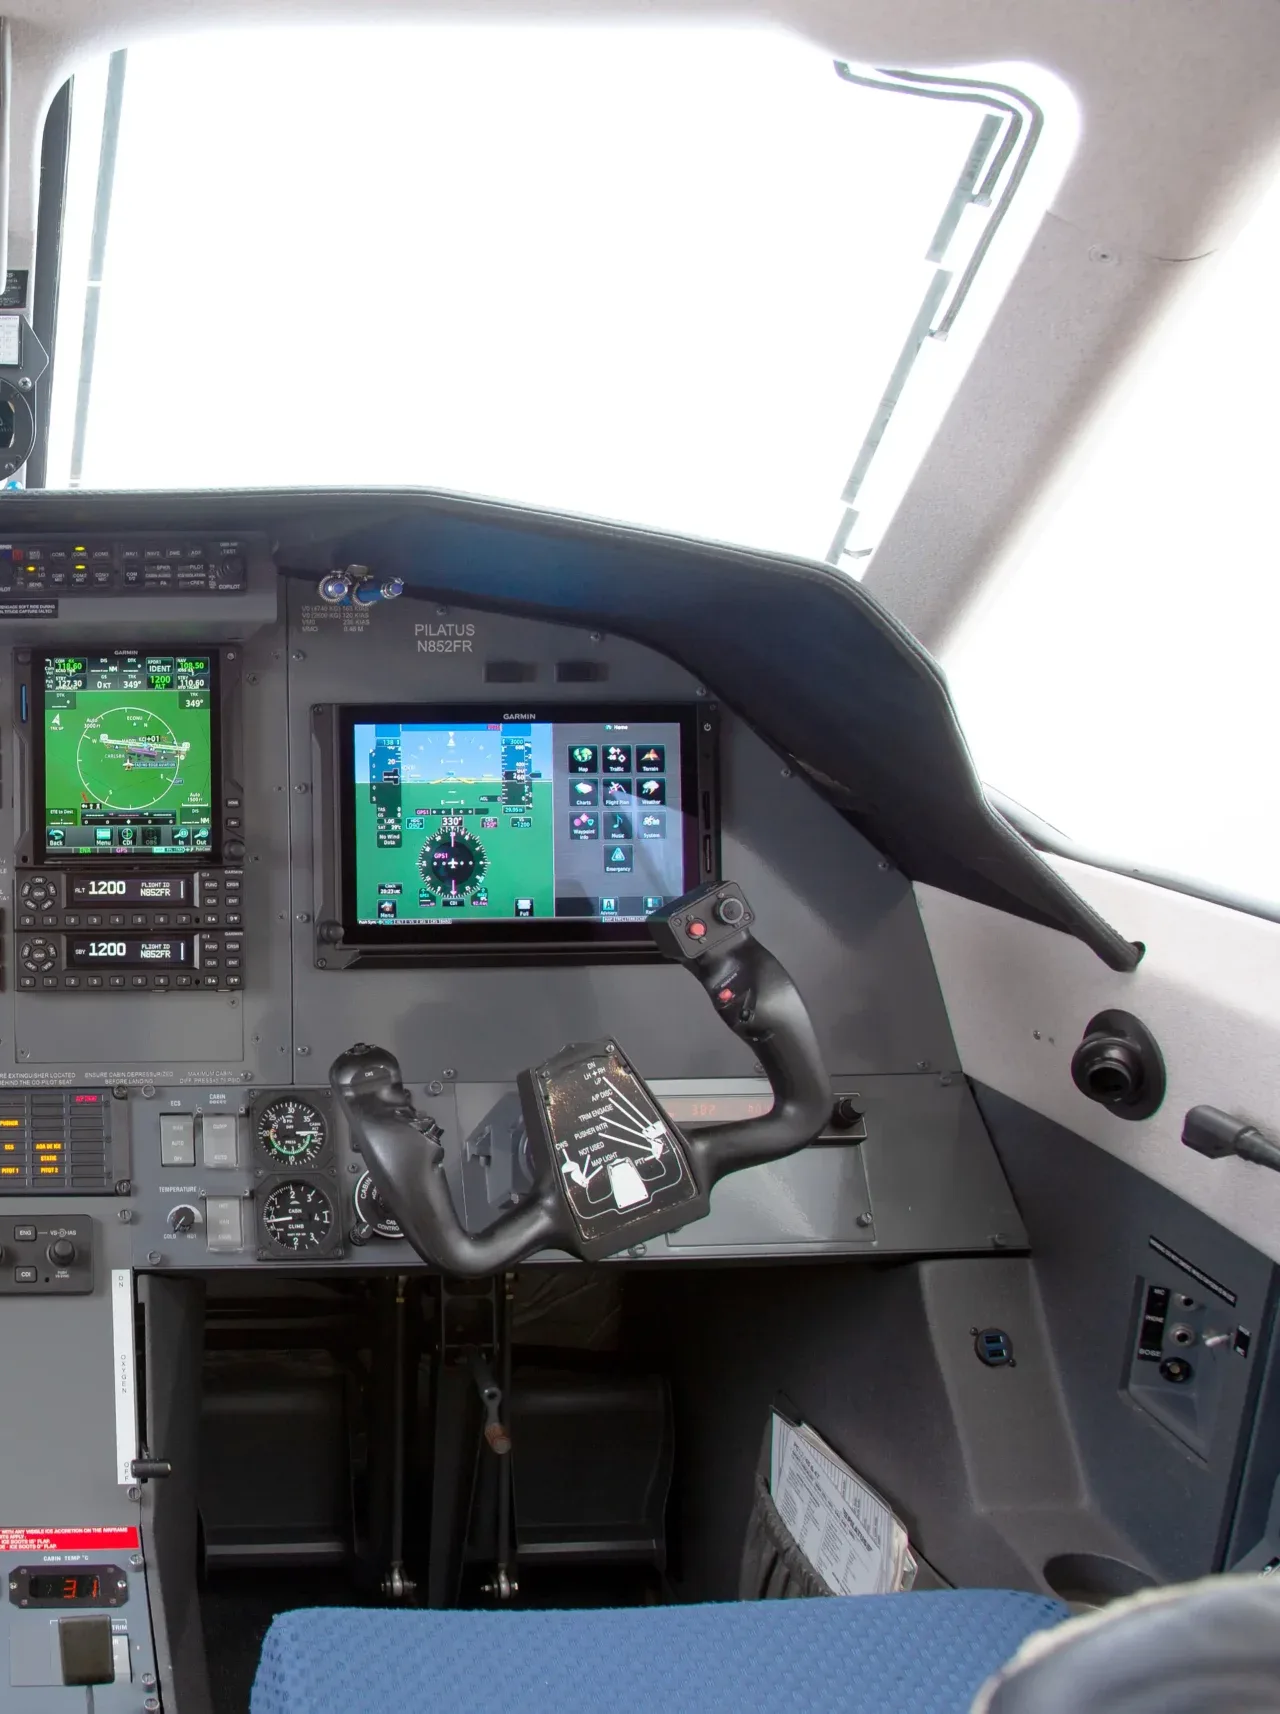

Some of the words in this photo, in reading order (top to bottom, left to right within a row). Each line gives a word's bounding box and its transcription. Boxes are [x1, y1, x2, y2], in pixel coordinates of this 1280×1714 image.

[415, 624, 475, 636] PILATUS
[417, 640, 473, 653] N852FR
[88, 881, 126, 895] 1200
[140, 888, 170, 896] N852FR
[88, 943, 126, 956] 1200
[140, 950, 170, 958] N852FR
[591, 1094, 600, 1102] A/P
[600, 1088, 613, 1098] DISC
[578, 1113, 592, 1122] TRIM
[592, 1104, 613, 1117] ENGAGE
[574, 1128, 596, 1140] PUSHER
[596, 1122, 608, 1132] INTR
[556, 1141, 568, 1150] CWS
[578, 1147, 589, 1155] NOT
[590, 1142, 604, 1151] USED
[591, 1159, 603, 1167] MAP
[603, 1152, 618, 1163] LIGHT
